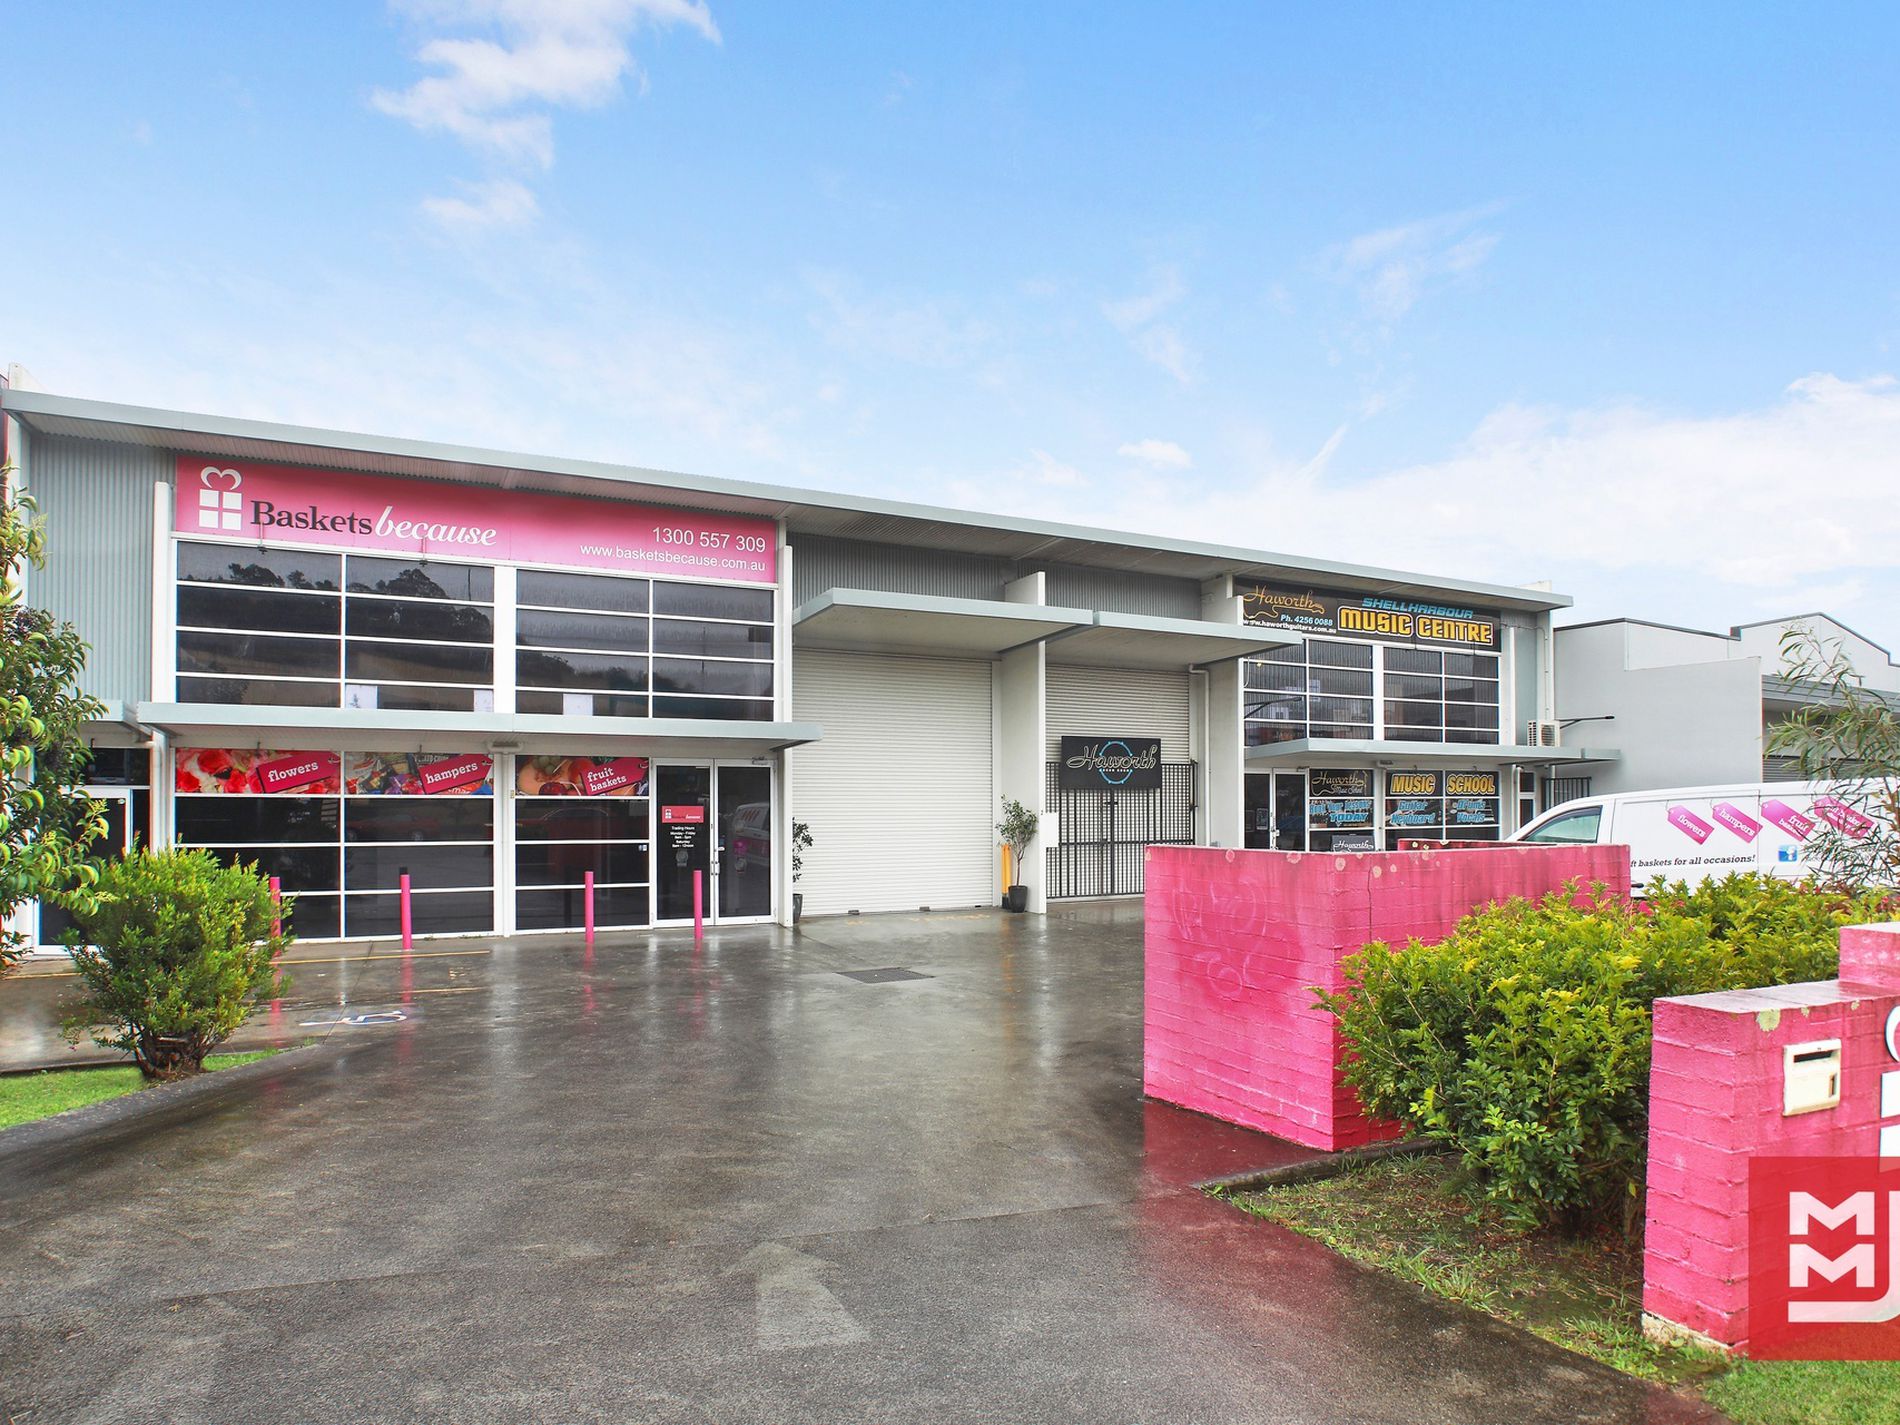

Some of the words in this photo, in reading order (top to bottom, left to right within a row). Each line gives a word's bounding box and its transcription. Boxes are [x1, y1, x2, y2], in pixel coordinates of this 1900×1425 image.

[250, 500, 373, 535] Baskets
[375, 505, 497, 545] because
[652, 527, 694, 545] 1300
[700, 531, 729, 549] 557
[735, 535, 766, 552] 309
[580, 544, 766, 571] www.basketsbecause.com.au
[1243, 585, 1318, 608] Haworth
[1362, 597, 1474, 619] SHELLHARBOUR
[1281, 614, 1293, 622] Ph.
[1294, 615, 1313, 624] 4256
[1314, 617, 1334, 626] 0088
[1340, 608, 1412, 636] MUSIC
[1417, 616, 1492, 643] CENTRE
[1066, 744, 1158, 770] Haworth
[267, 761, 319, 782] flowers
[426, 762, 478, 784] hampers
[587, 768, 614, 782] fruit
[590, 775, 627, 792] baskets
[1391, 774, 1436, 794] MUSIC
[1447, 774, 1495, 794] SCHOOL
[1398, 800, 1428, 811] Guitar
[1457, 799, 1486, 810] Drums
[1329, 812, 1368, 822] TODAY
[1677, 814, 1706, 839] flowers
[1719, 808, 1755, 837] hampers
[1638, 859, 1672, 867] baskets
[1674, 858, 1686, 866] for
[1689, 857, 1701, 865] all
[1703, 854, 1756, 864] occasions!
